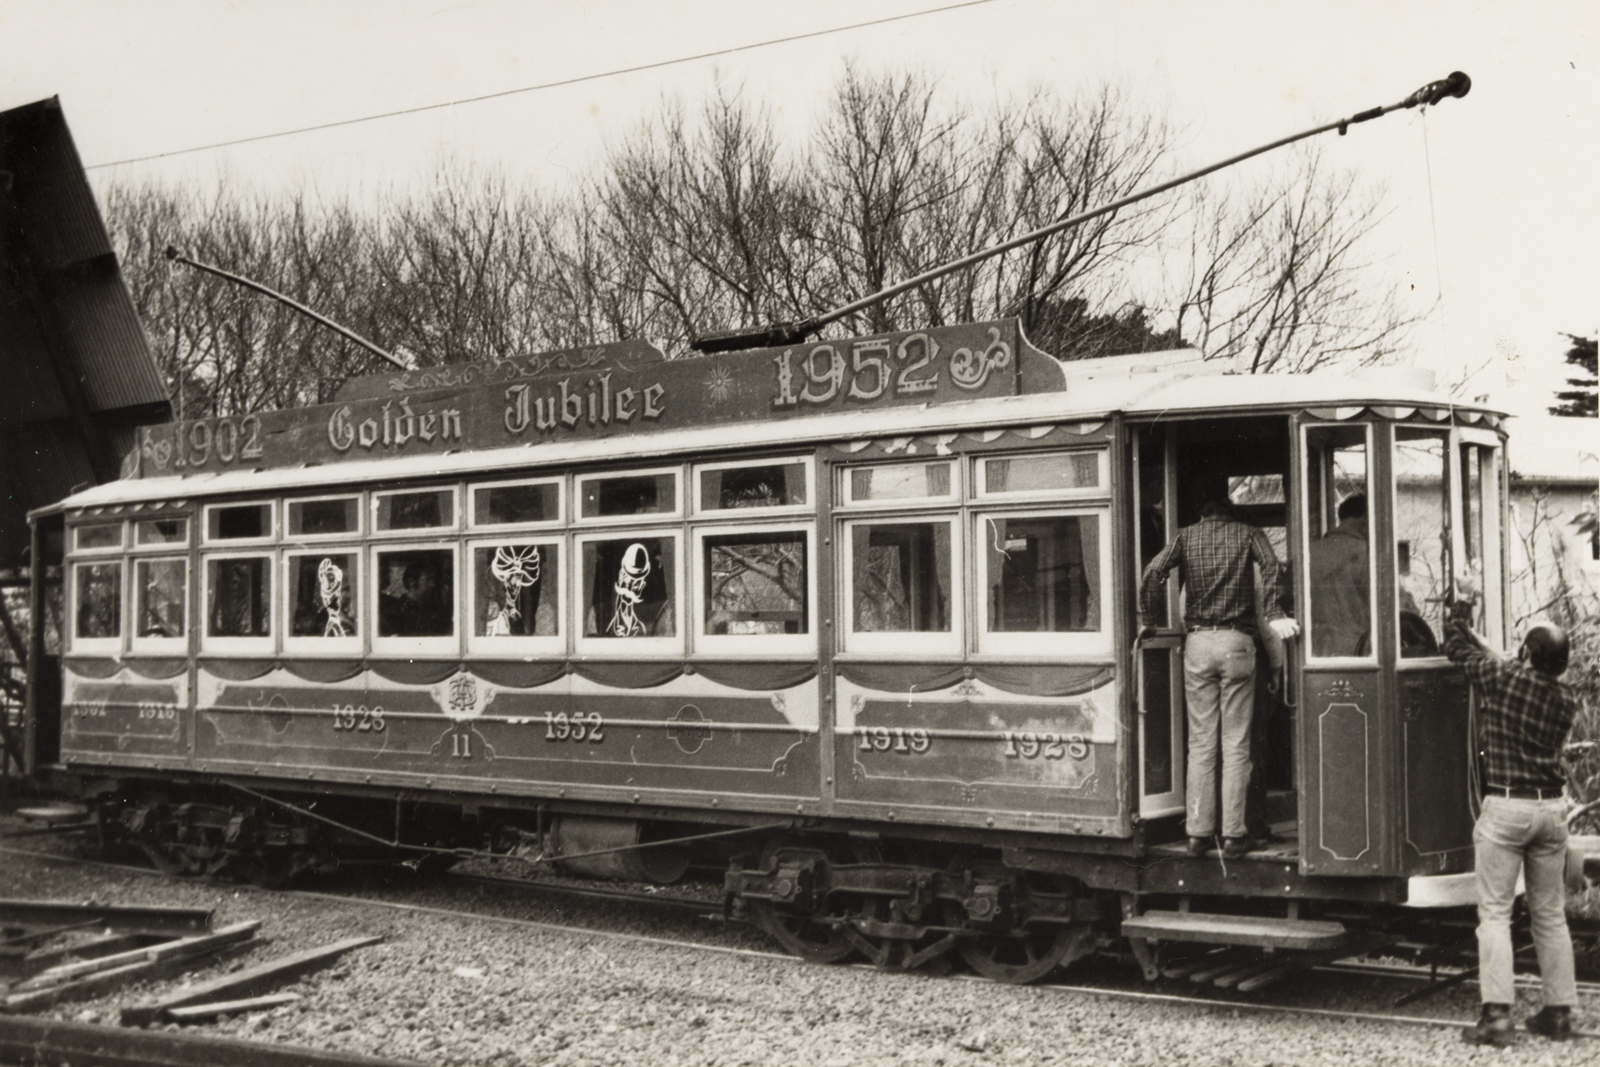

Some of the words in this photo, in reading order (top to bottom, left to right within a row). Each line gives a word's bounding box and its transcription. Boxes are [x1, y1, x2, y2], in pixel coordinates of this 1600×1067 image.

[175, 414, 263, 467] 1902
[328, 396, 462, 450] Golden
[504, 375, 665, 433] Jubilee
[771, 333, 940, 404] 1952
[332, 704, 386, 731] 1928
[544, 711, 603, 740] 1952
[451, 734, 471, 757] 11
[858, 727, 930, 751] 1919
[1004, 732, 1090, 759] 1928
